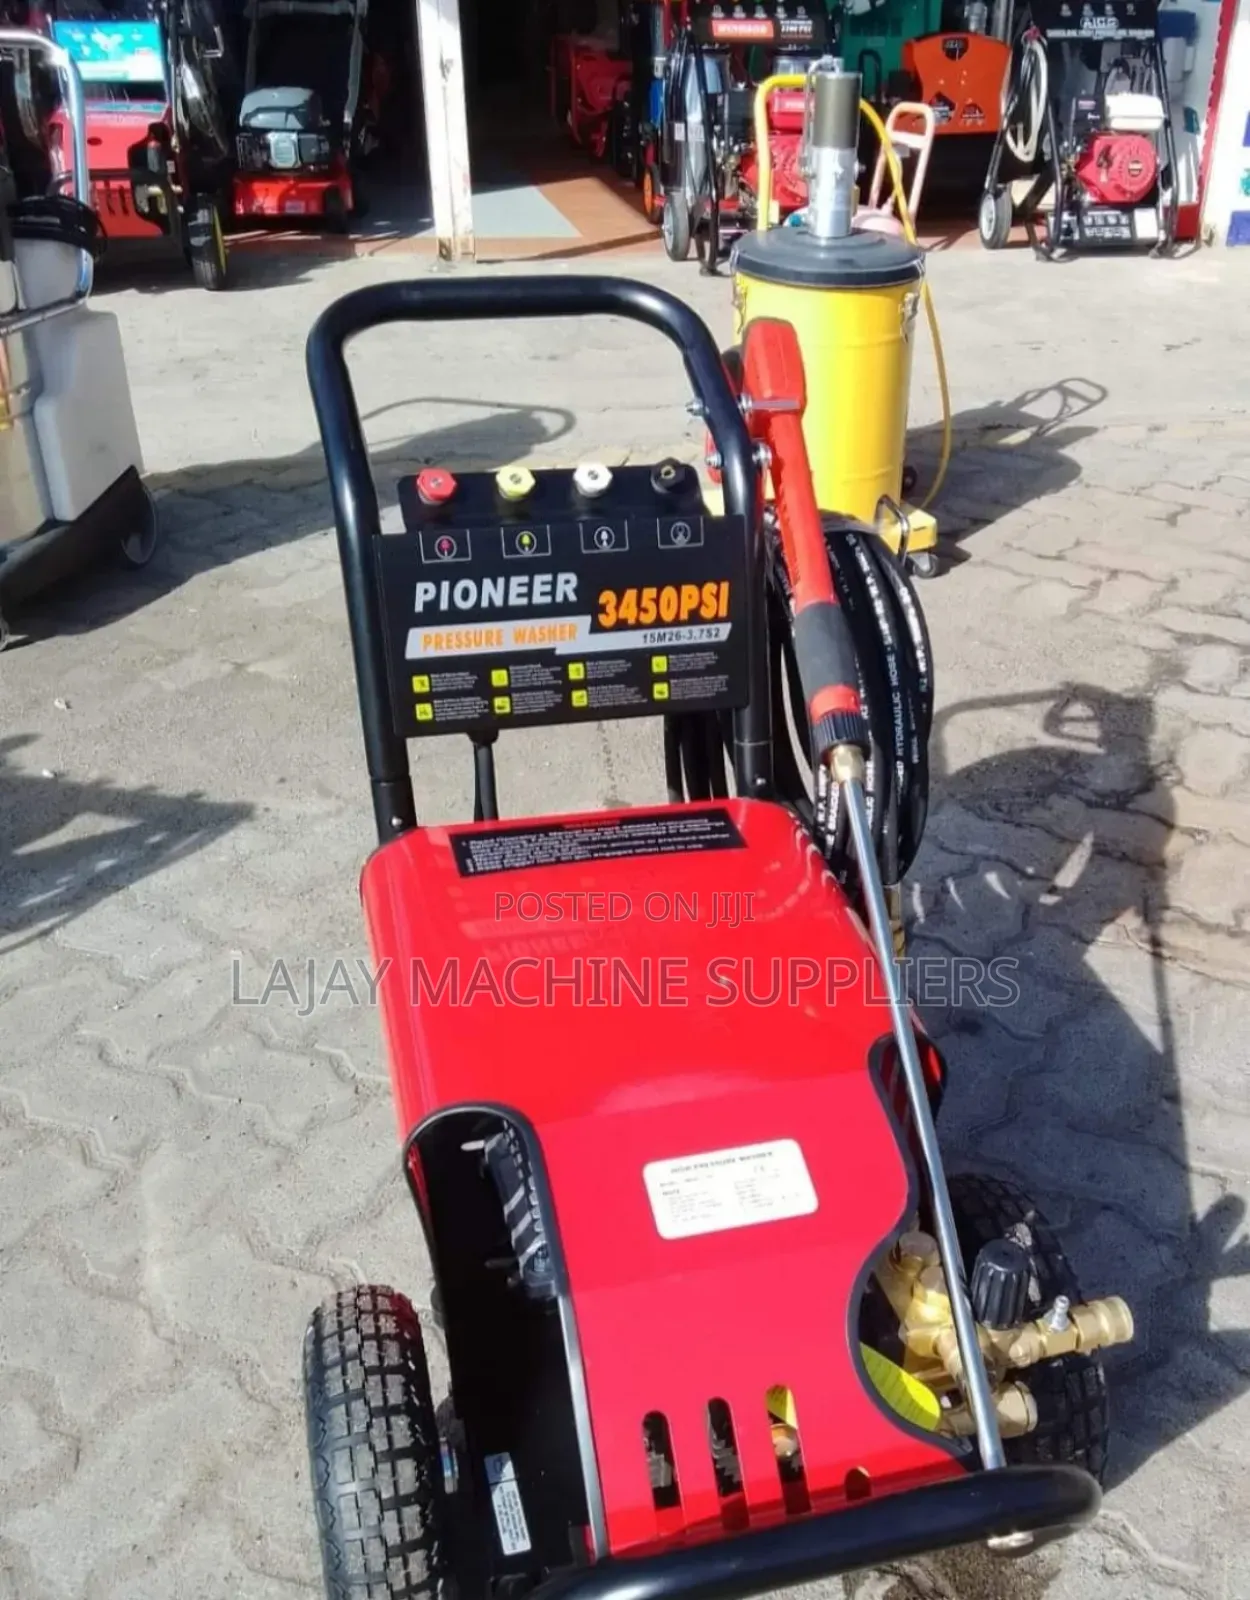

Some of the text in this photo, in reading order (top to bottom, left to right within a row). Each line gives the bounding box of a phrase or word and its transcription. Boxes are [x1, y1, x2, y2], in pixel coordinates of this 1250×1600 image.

[414, 572, 578, 613] PIONEER
[598, 581, 730, 628] 3450PSI
[422, 622, 578, 651] PRESSURE WASHER
[887, 653, 899, 687] HOSE
[892, 692, 905, 756] HYDRAULIC
